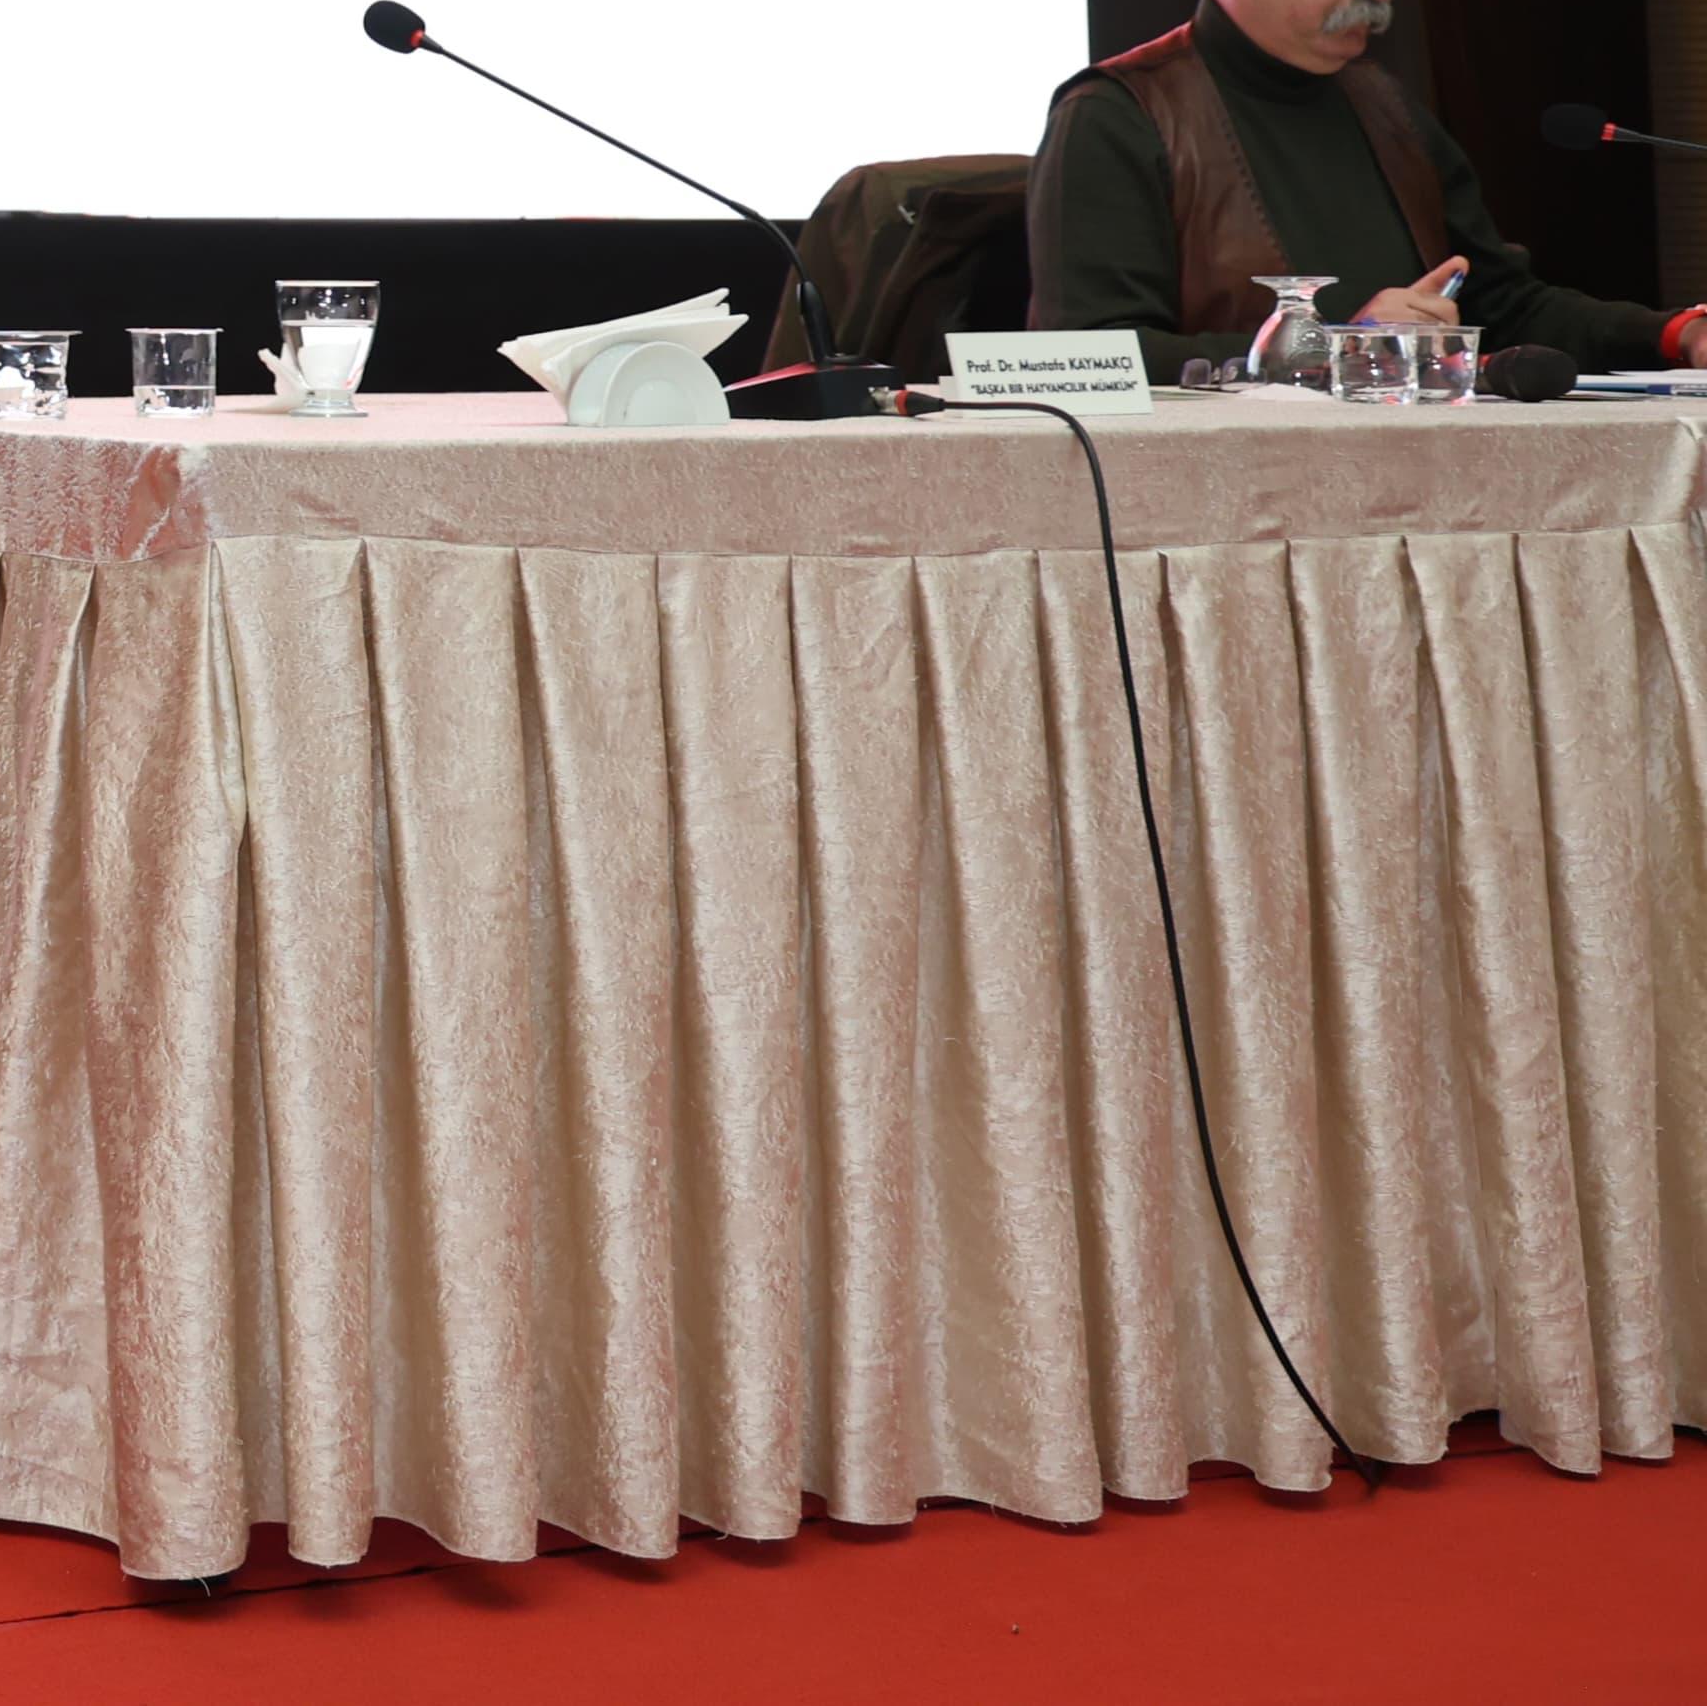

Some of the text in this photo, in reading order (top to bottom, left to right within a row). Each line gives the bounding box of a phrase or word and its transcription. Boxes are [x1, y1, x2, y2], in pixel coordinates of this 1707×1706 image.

[967, 356, 1133, 373] Prof. Dr. Mustafa KAYMAKÇI
[1009, 380, 1023, 394] BİR
[1027, 382, 1087, 393] HAYVANCILIK
